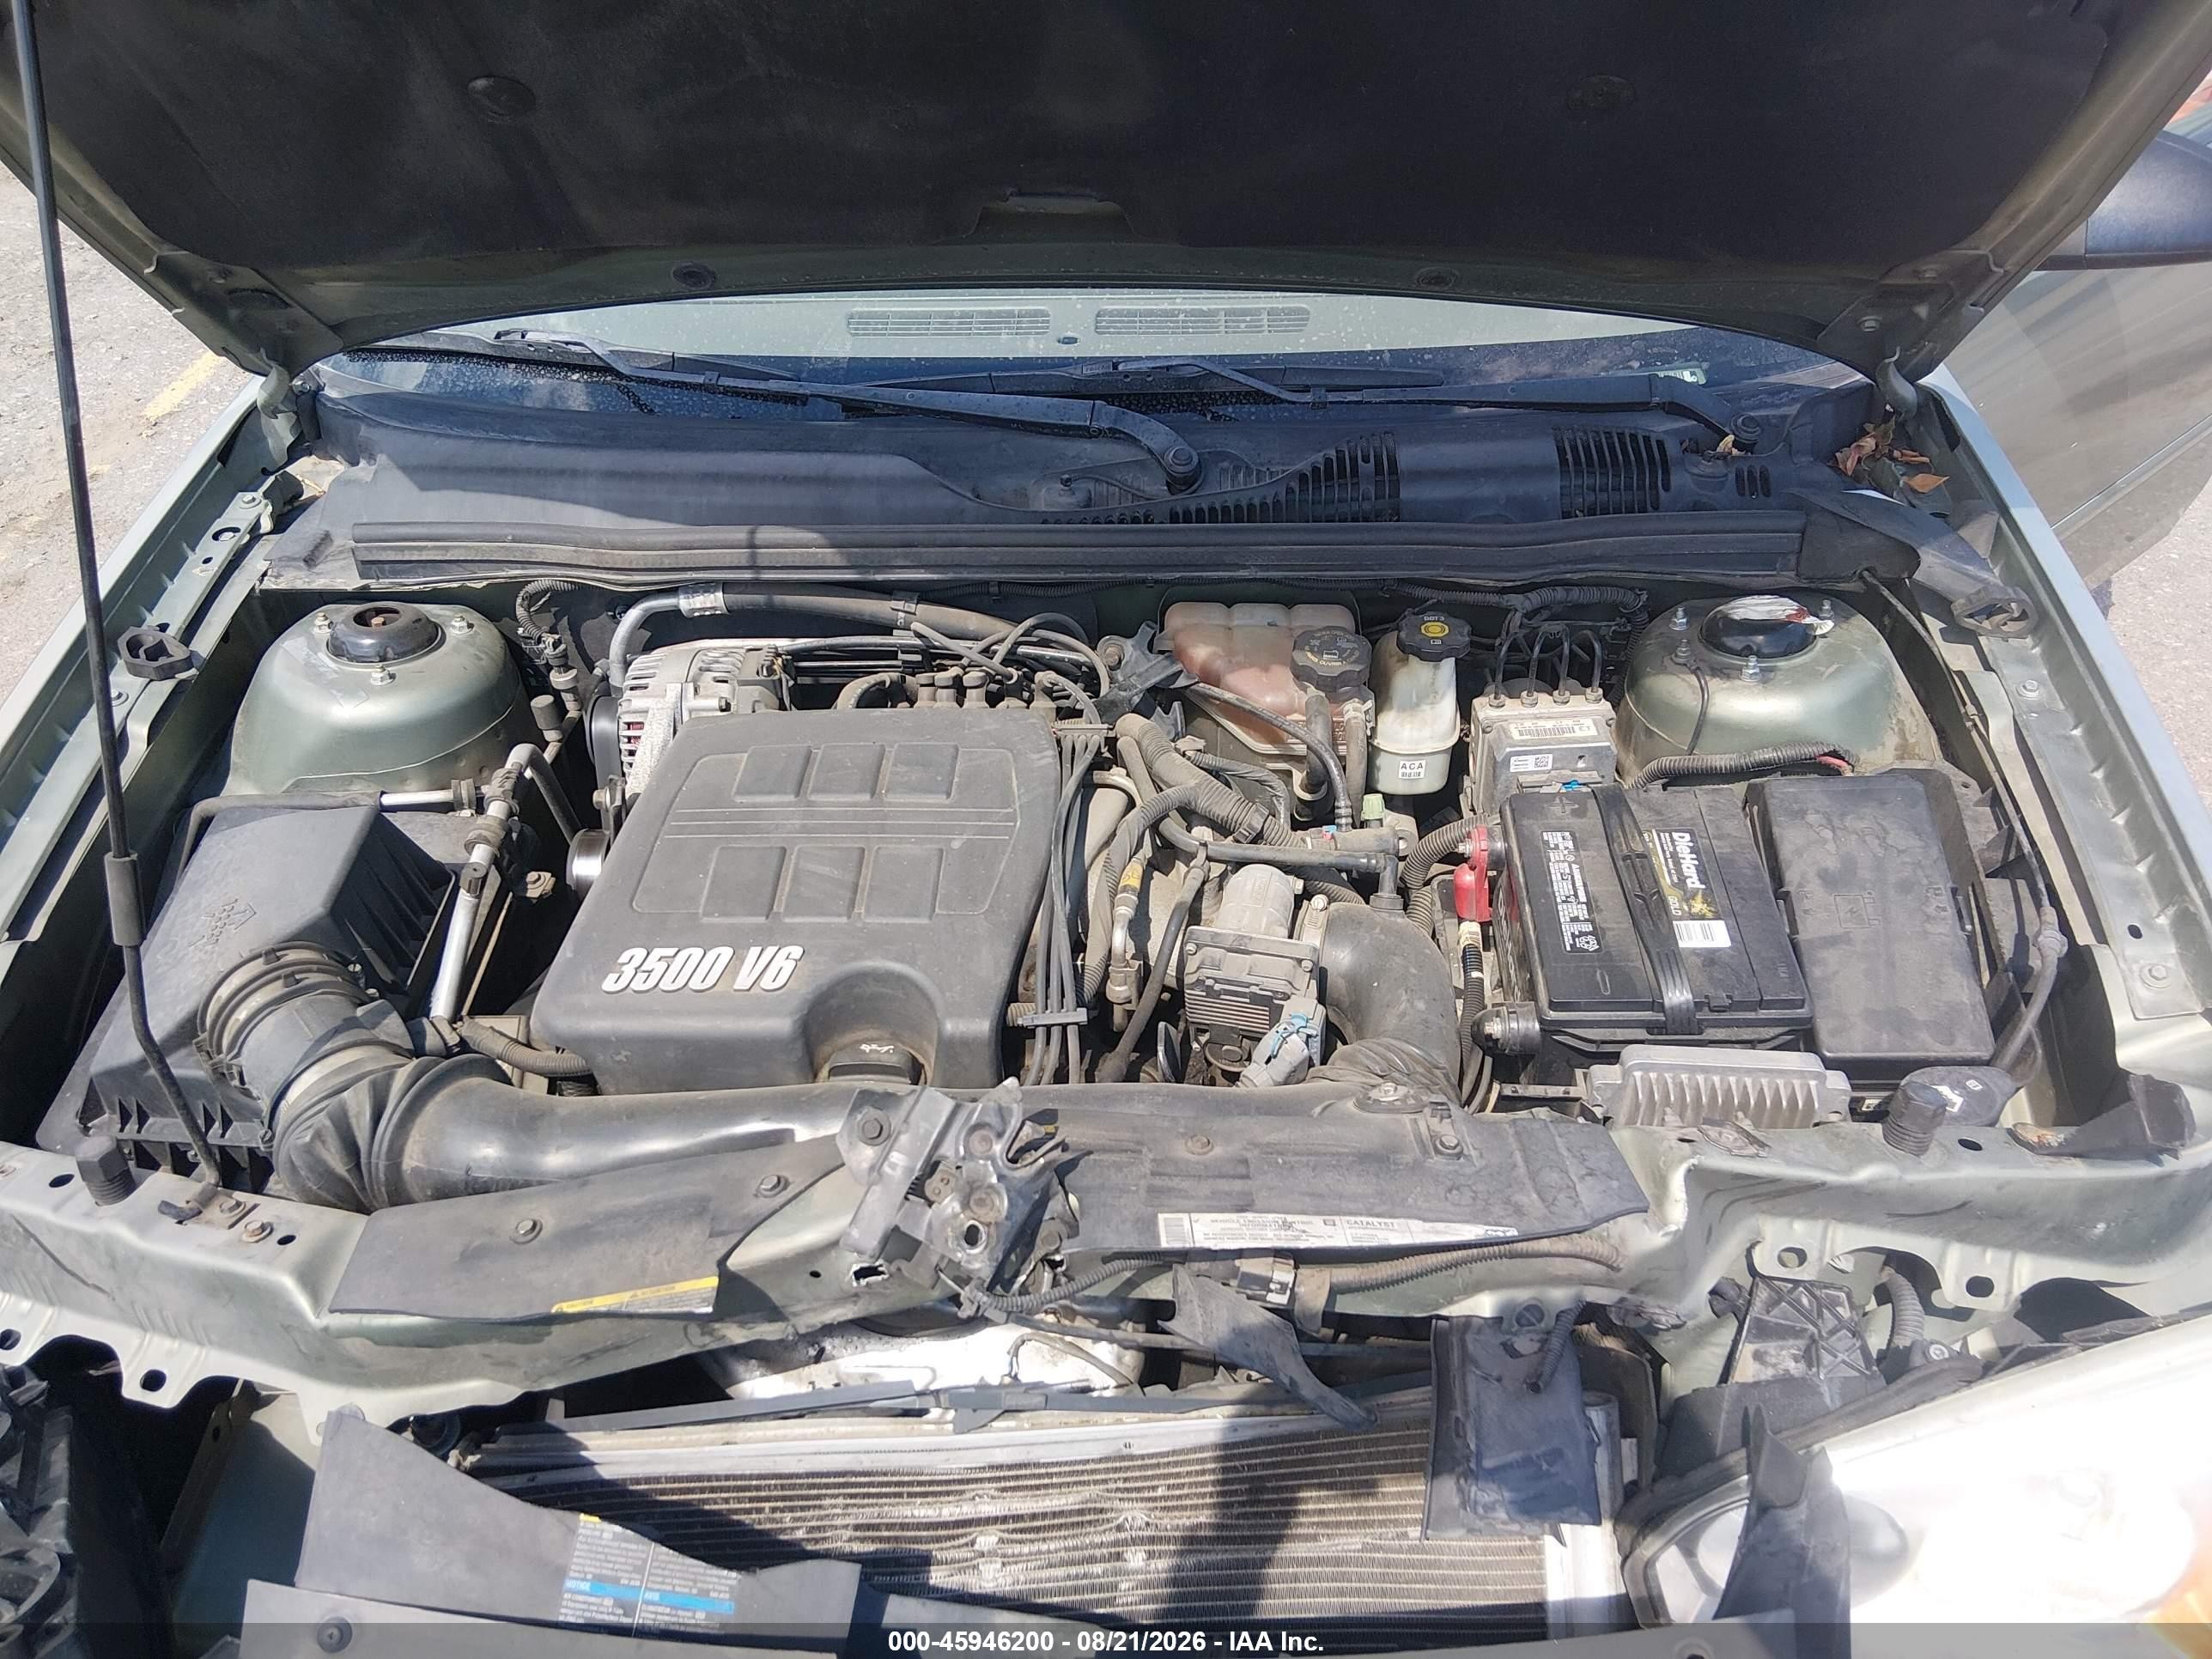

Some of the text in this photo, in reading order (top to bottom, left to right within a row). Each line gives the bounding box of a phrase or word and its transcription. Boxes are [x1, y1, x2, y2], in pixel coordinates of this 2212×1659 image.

[1401, 762, 1424, 770] ACA
[1672, 831, 1706, 889] DieHard
[1668, 896, 1682, 916] GOLD
[601, 945, 805, 994] 3500 V6
[1347, 1219, 1395, 1228] CATALYST
